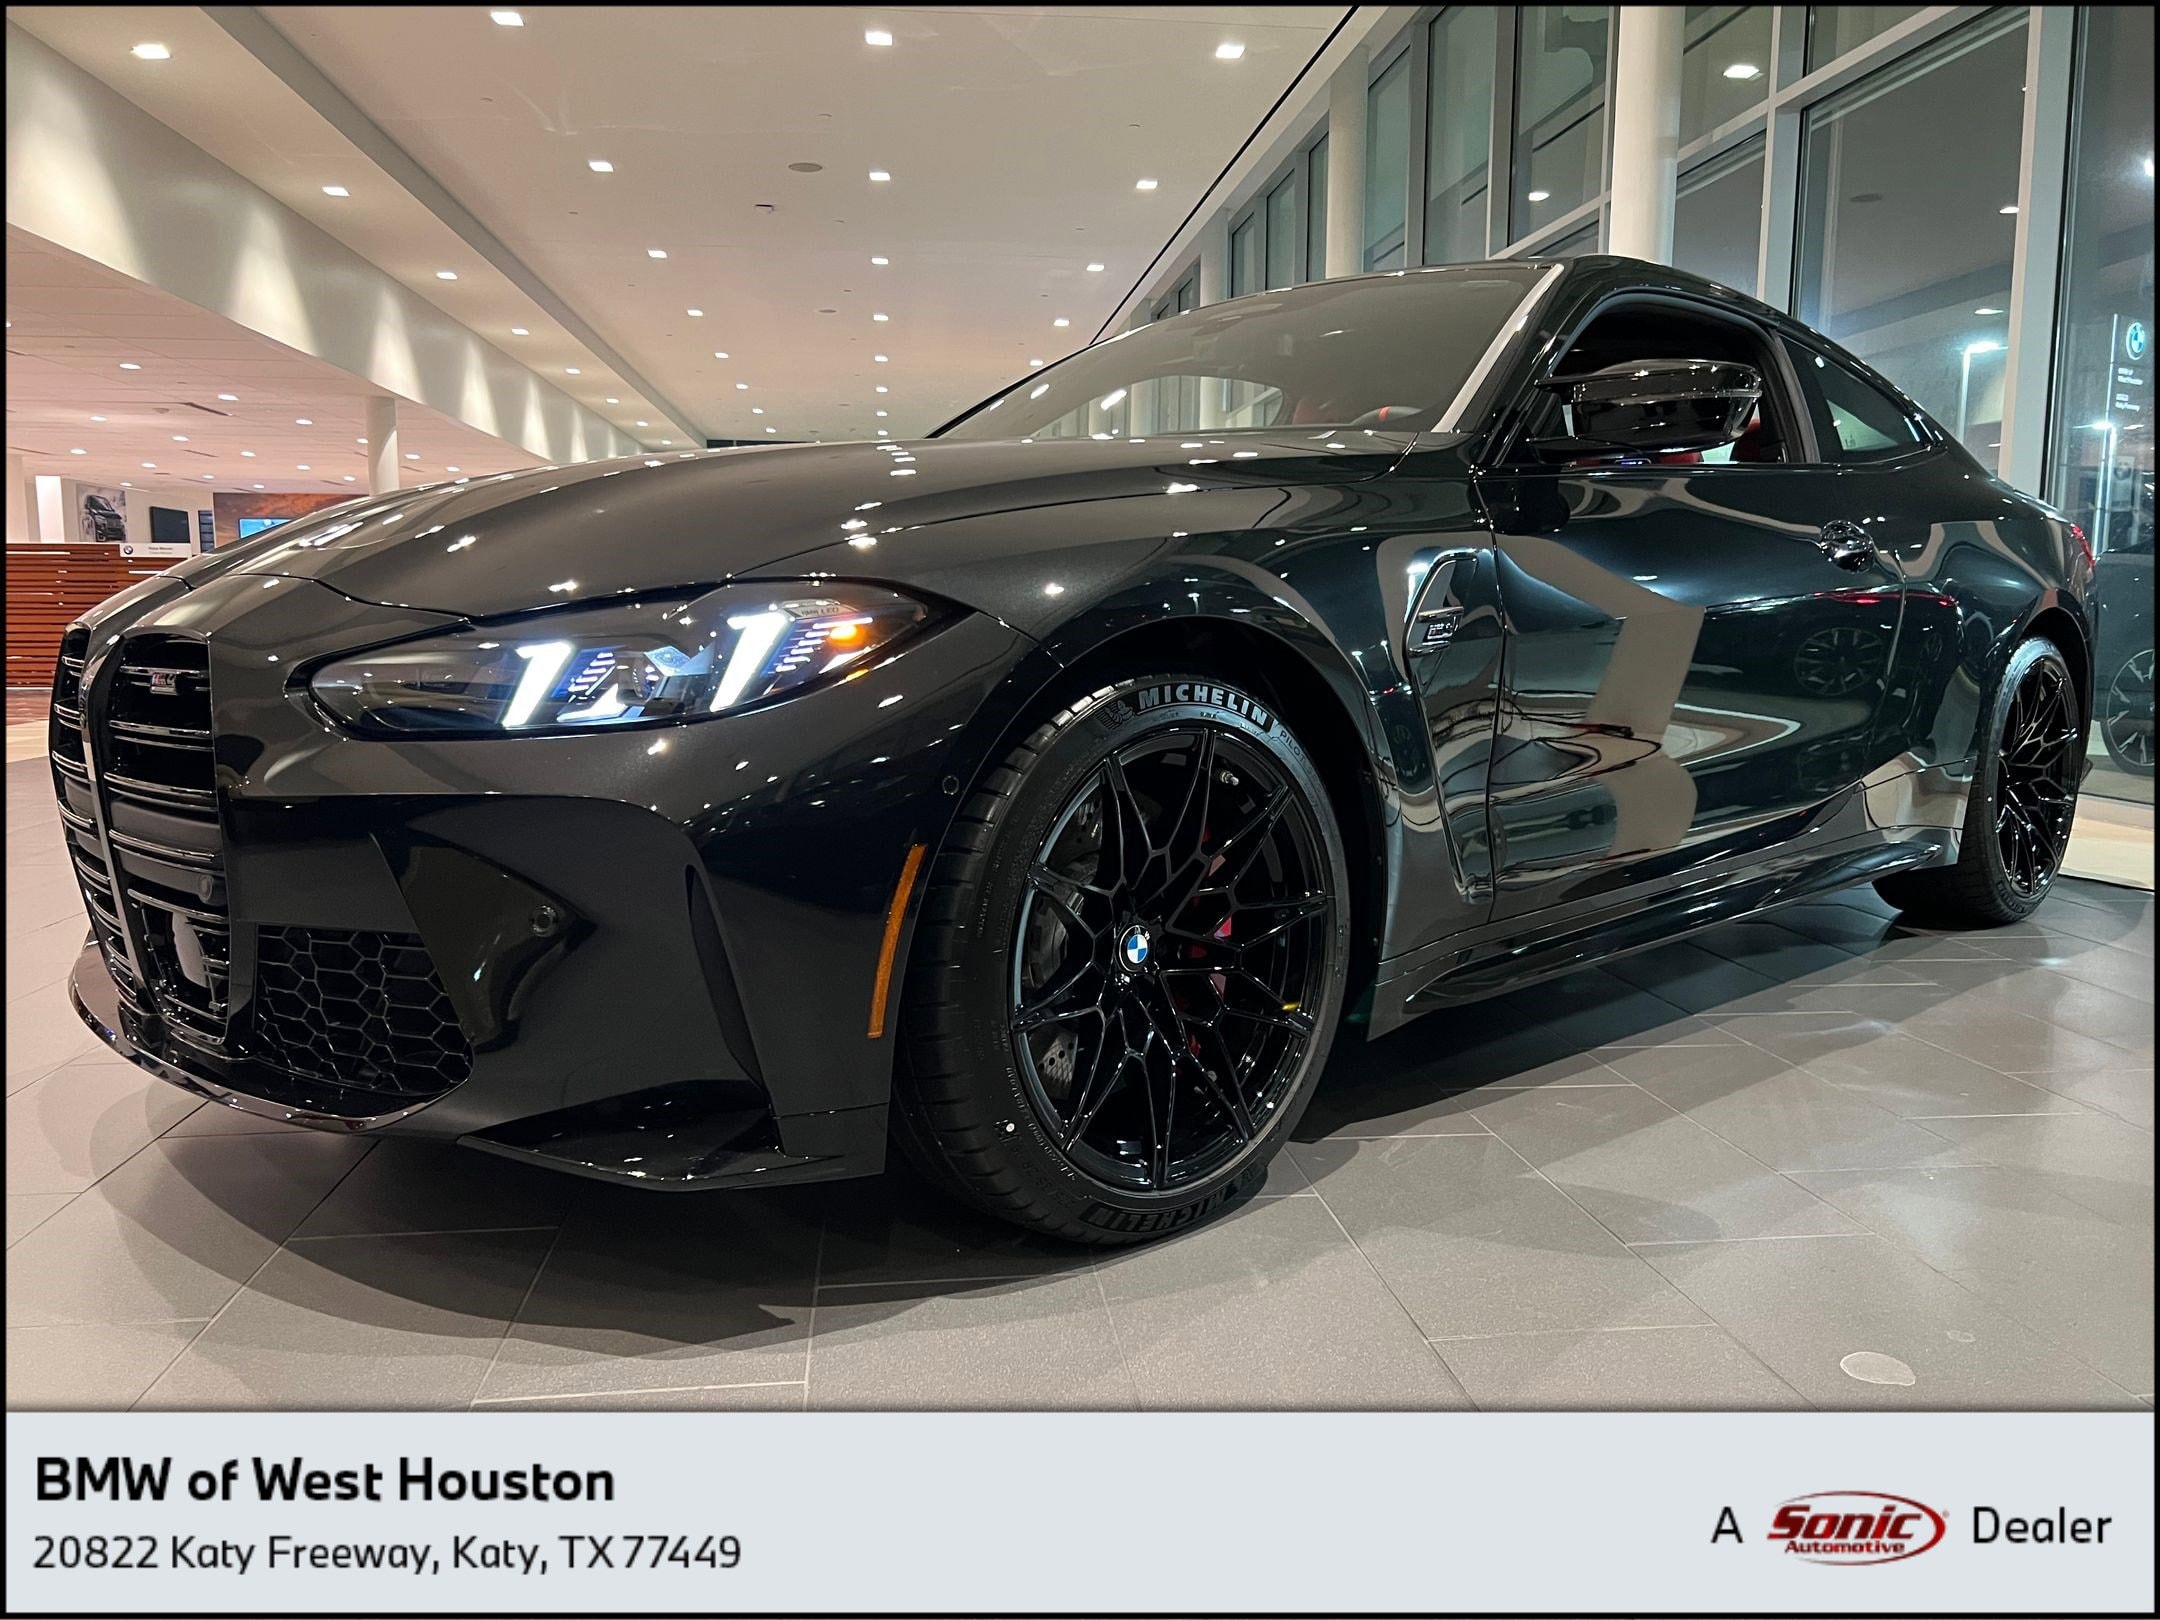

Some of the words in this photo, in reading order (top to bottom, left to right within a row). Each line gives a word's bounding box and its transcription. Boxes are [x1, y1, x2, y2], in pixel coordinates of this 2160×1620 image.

[1138, 683, 1268, 727] MICHELIN
[1279, 729, 1307, 763] PILOT
[1091, 1189, 1227, 1232] MICHELIN
